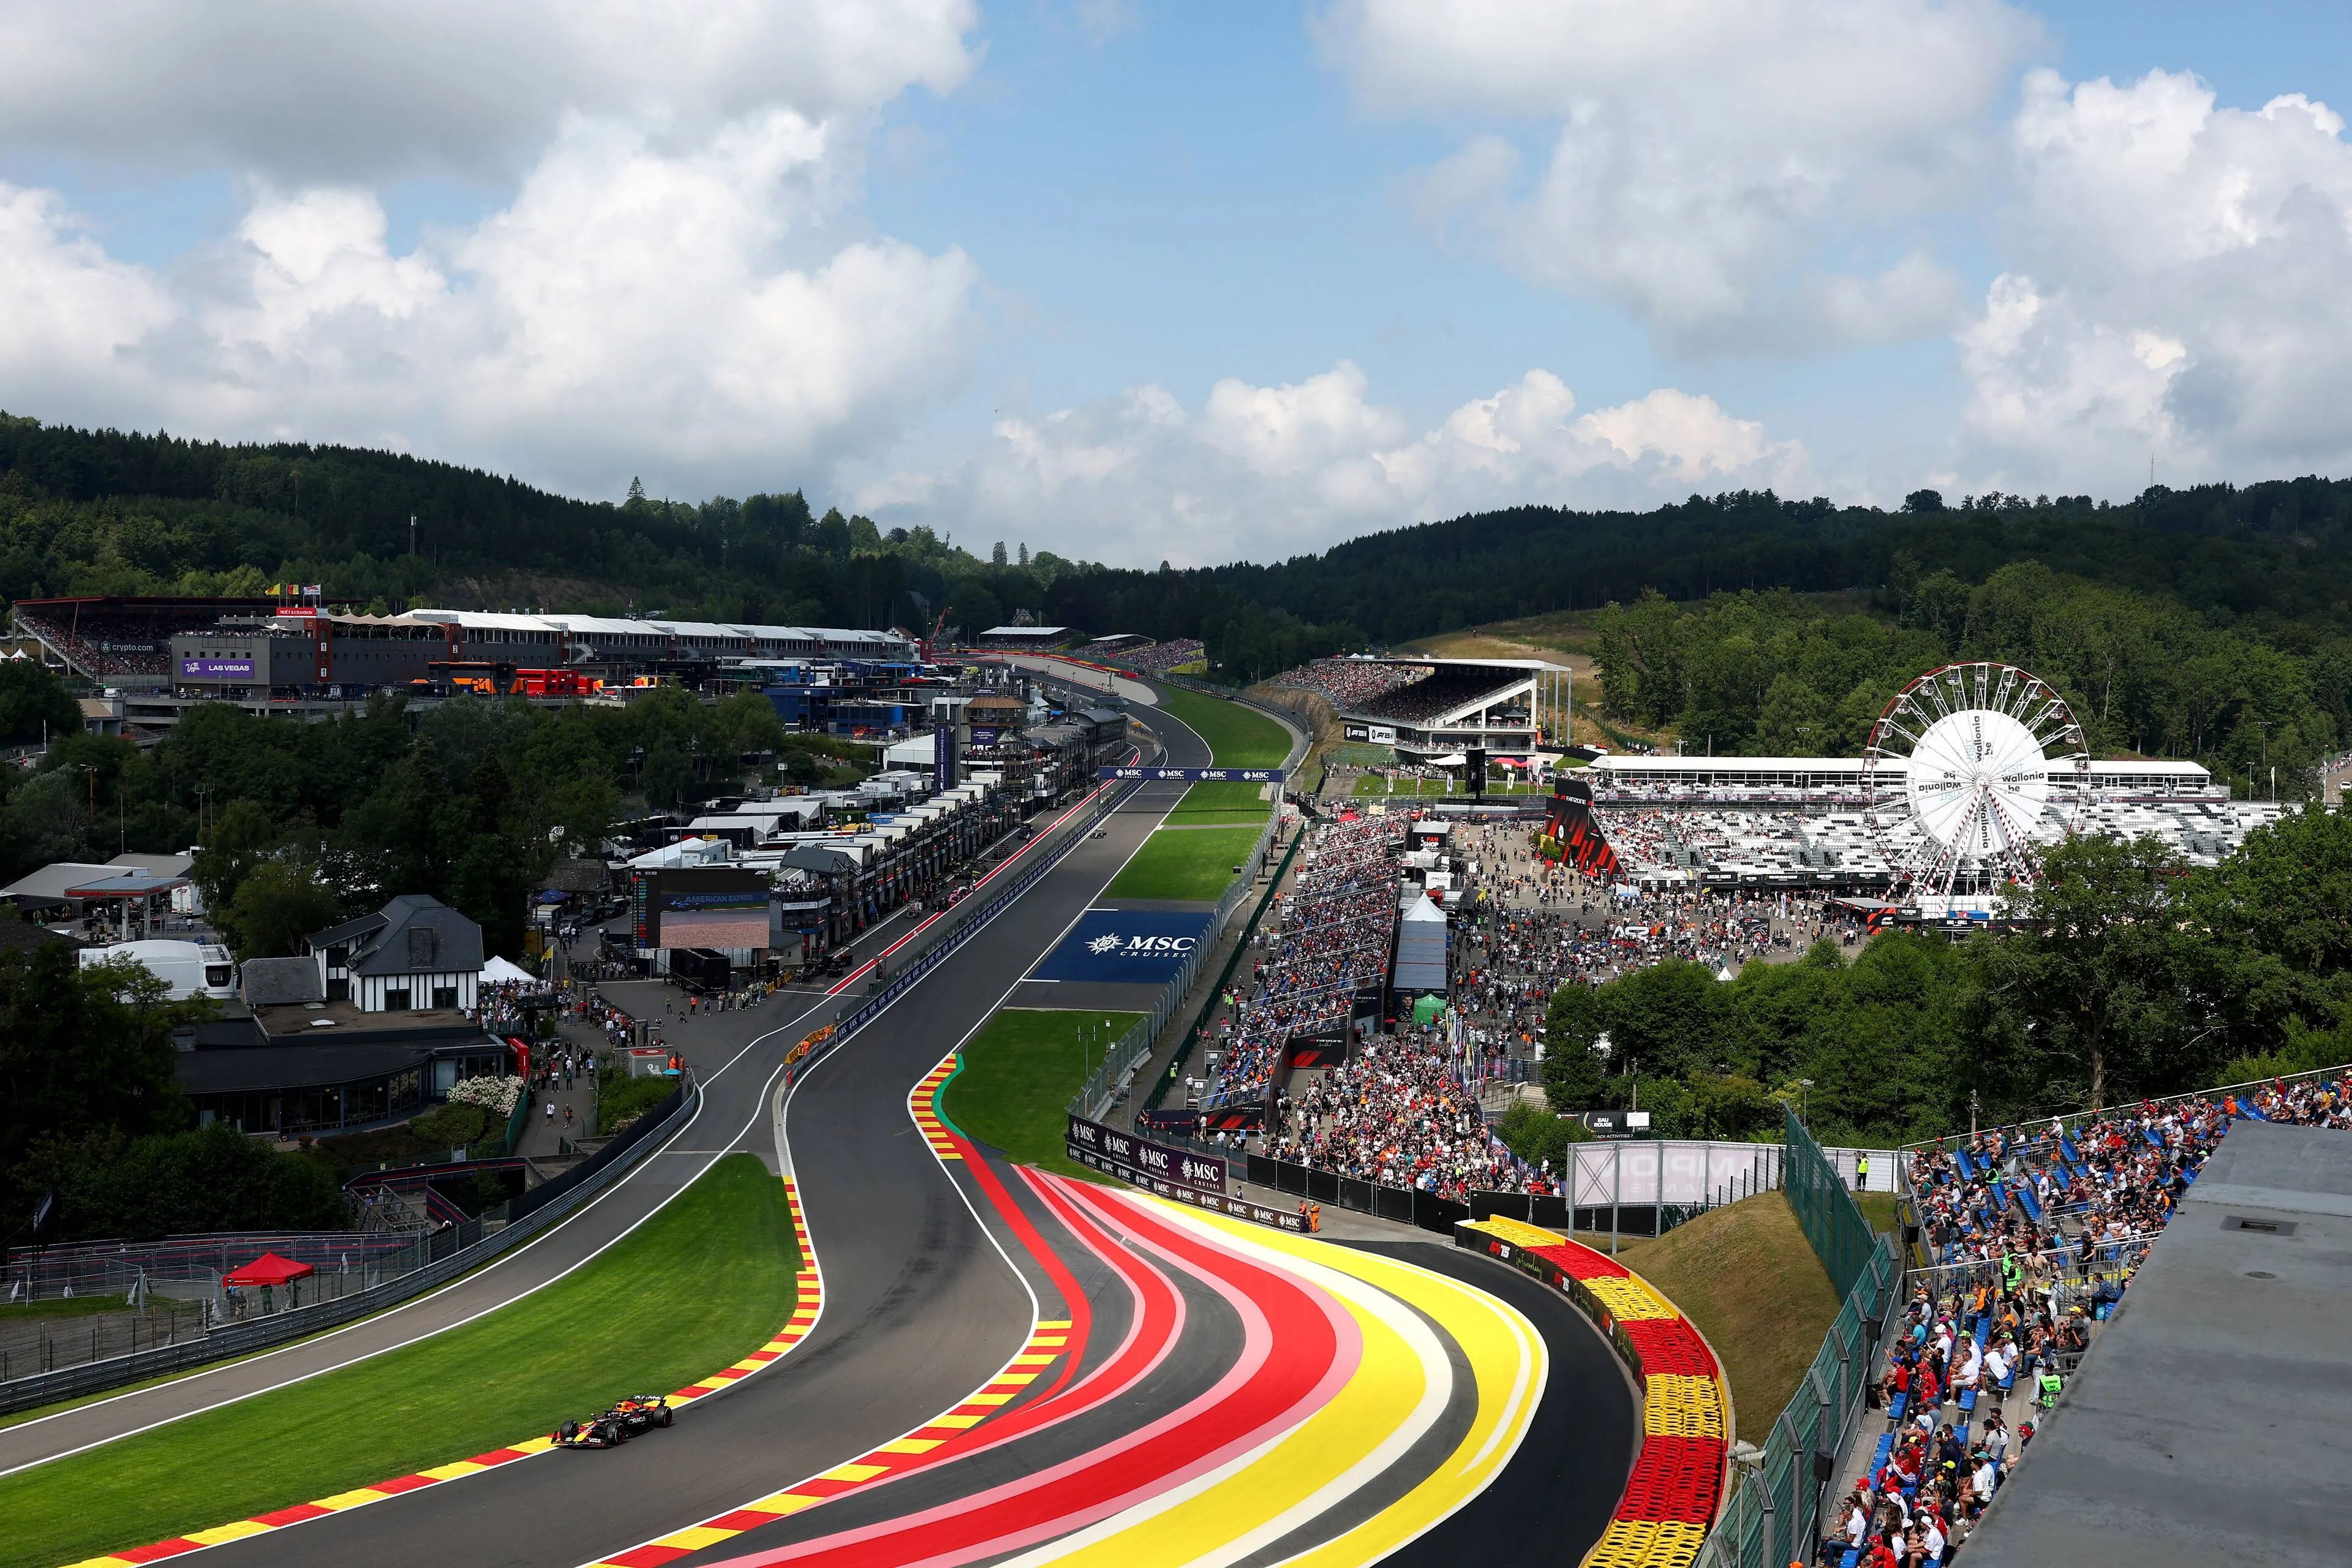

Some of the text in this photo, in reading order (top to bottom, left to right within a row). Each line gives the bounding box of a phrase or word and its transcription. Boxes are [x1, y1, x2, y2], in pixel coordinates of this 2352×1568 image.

[112, 643, 153, 654] crypto.com
[1973, 715, 1982, 762] wallonia
[2002, 772, 2045, 782] wallonia
[1918, 782, 1961, 793] wallonia
[1566, 796, 1586, 805] FANZONE
[1980, 803, 1990, 848] wallonia
[1125, 936, 1196, 951] MSC
[1079, 1124, 1095, 1142] MSC
[1080, 1140, 1096, 1150] CRUISES
[1112, 1136, 1130, 1156] MSC
[1072, 1150, 1081, 1158] MSC
[1113, 1153, 1130, 1164] CRUISES
[1148, 1149, 1168, 1169] MSC
[1088, 1155, 1096, 1165] MSC
[1105, 1162, 1114, 1172] MSC
[1149, 1166, 1169, 1177] CRUISES
[1194, 1162, 1219, 1182] MSC
[1121, 1168, 1130, 1178] MSC
[1139, 1176, 1149, 1186] MSC
[1194, 1180, 1219, 1190] CRUISES
[1157, 1182, 1169, 1193] MSC
[1182, 1190, 1194, 1200] MSC
[1206, 1195, 1219, 1206] MSC
[1234, 1203, 1247, 1214] MSC
[1260, 1210, 1274, 1221] MSC
[1286, 1216, 1300, 1227] MSC
[628, 1416, 646, 1425] ORACLE
